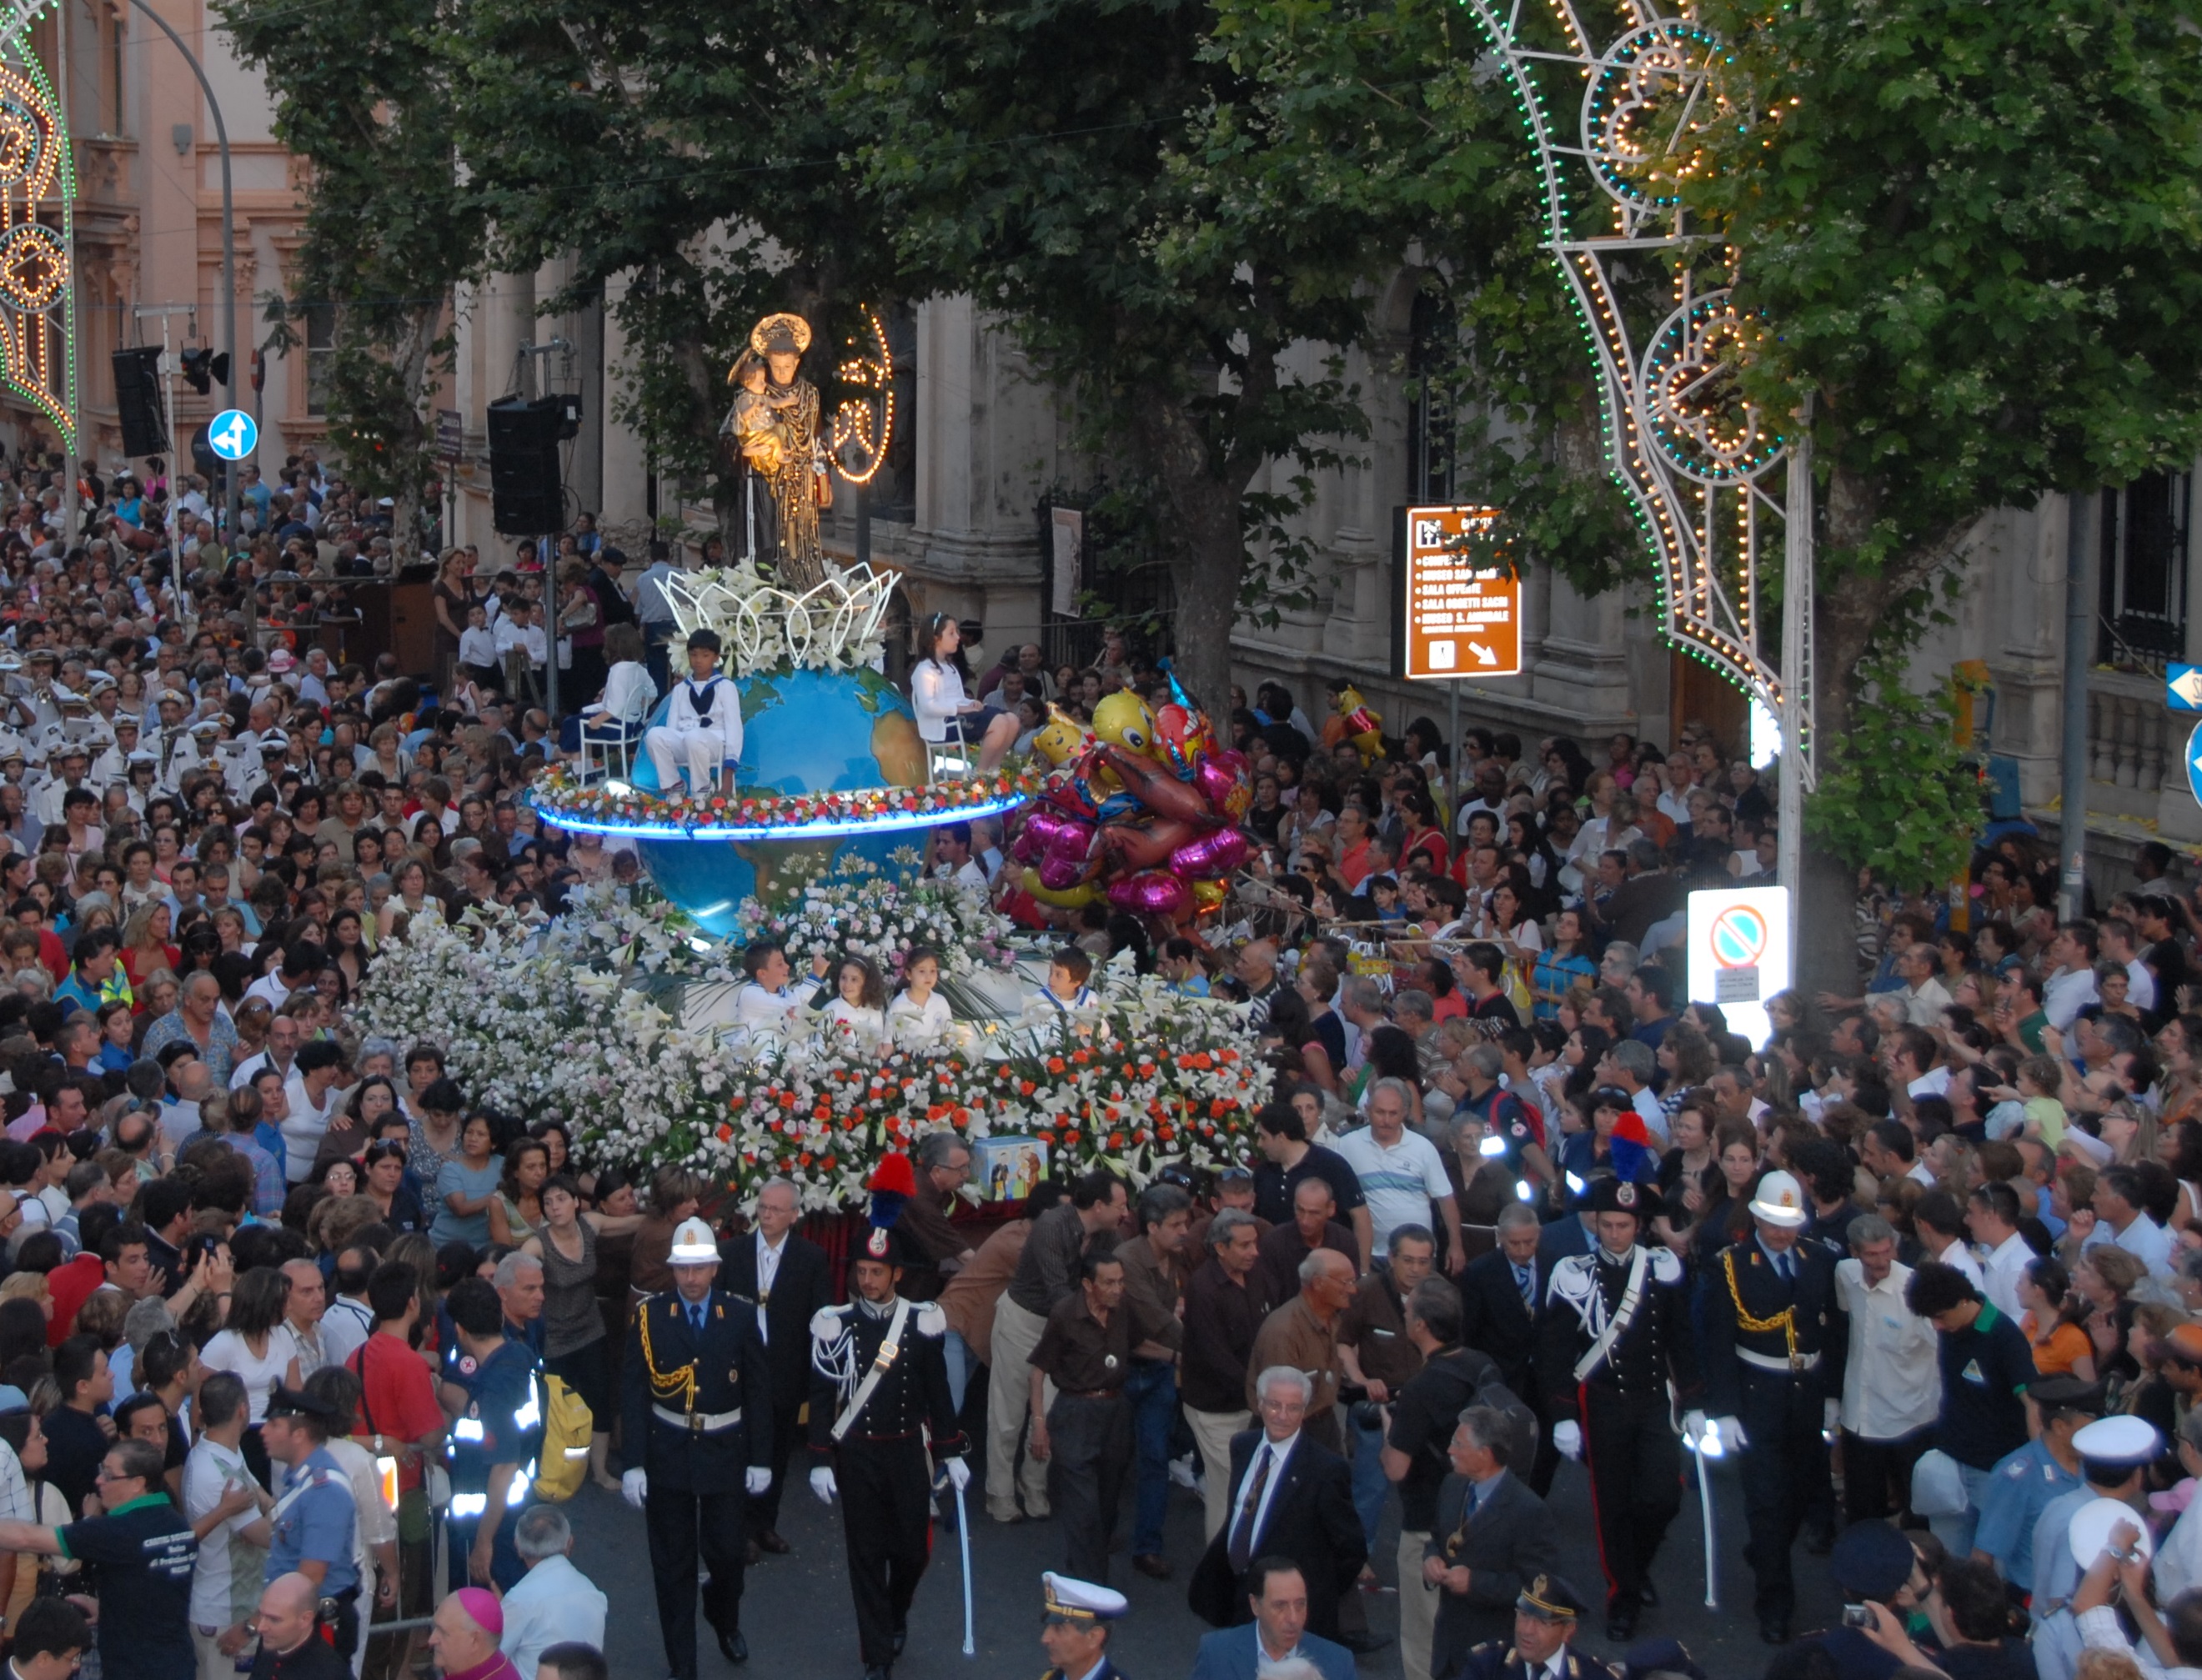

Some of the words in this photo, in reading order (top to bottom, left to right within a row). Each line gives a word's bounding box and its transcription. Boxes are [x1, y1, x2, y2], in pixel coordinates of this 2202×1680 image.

[1422, 569, 1453, 581] MUSEO
[1422, 584, 1445, 595] SALA
[1422, 599, 1445, 609] SALA
[1446, 597, 1481, 609] OGGETTI
[1482, 596, 1508, 608] SACRI
[1422, 613, 1453, 624] MUSEO
[1456, 612, 1466, 623] S.
[1466, 610, 1509, 622] ANNIBALE
